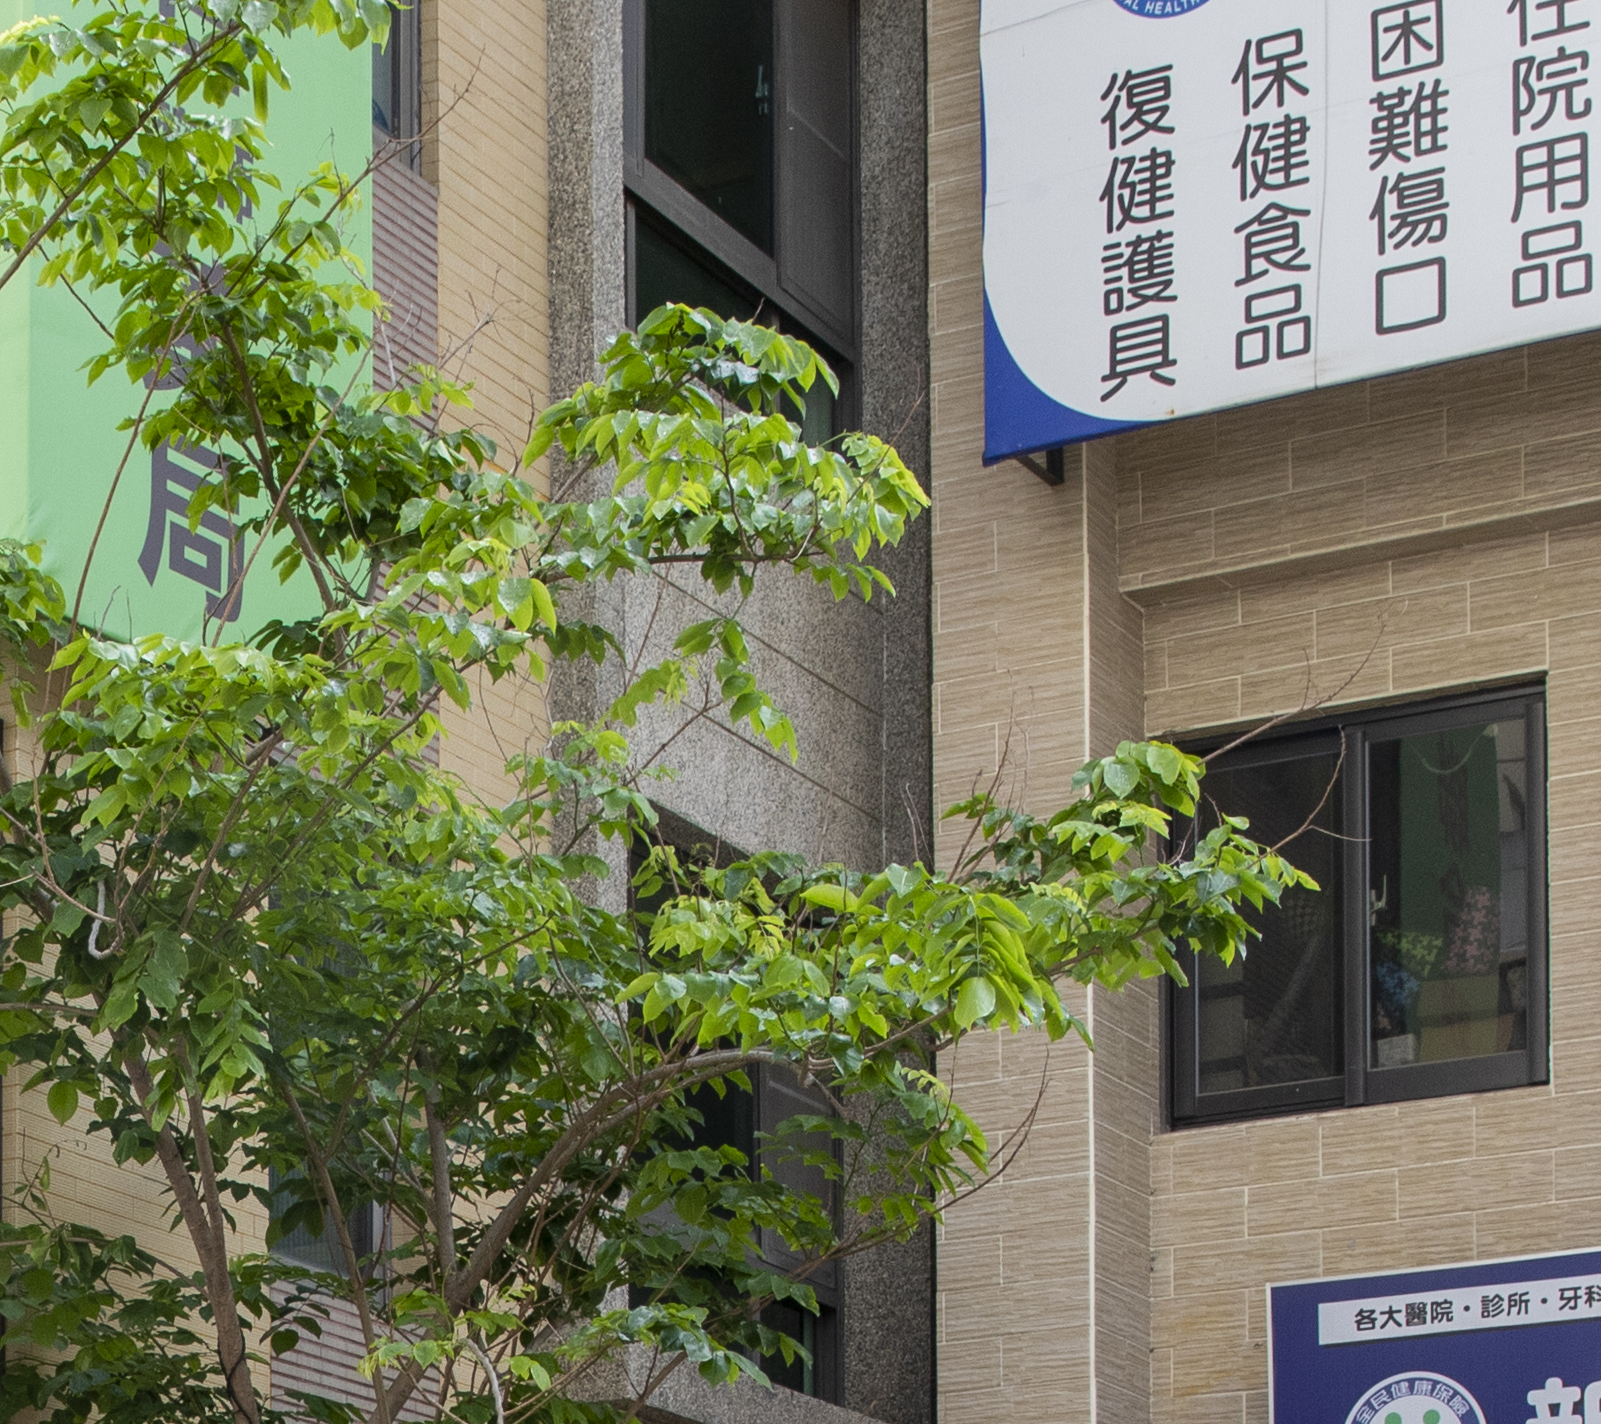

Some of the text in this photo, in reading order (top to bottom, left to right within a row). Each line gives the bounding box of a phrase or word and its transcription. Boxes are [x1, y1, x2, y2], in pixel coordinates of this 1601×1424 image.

[1099, 63, 1178, 402] 復健護具
[1231, 28, 1312, 370] 保健食品
[1369, 0, 1450, 335] 困難傷口
